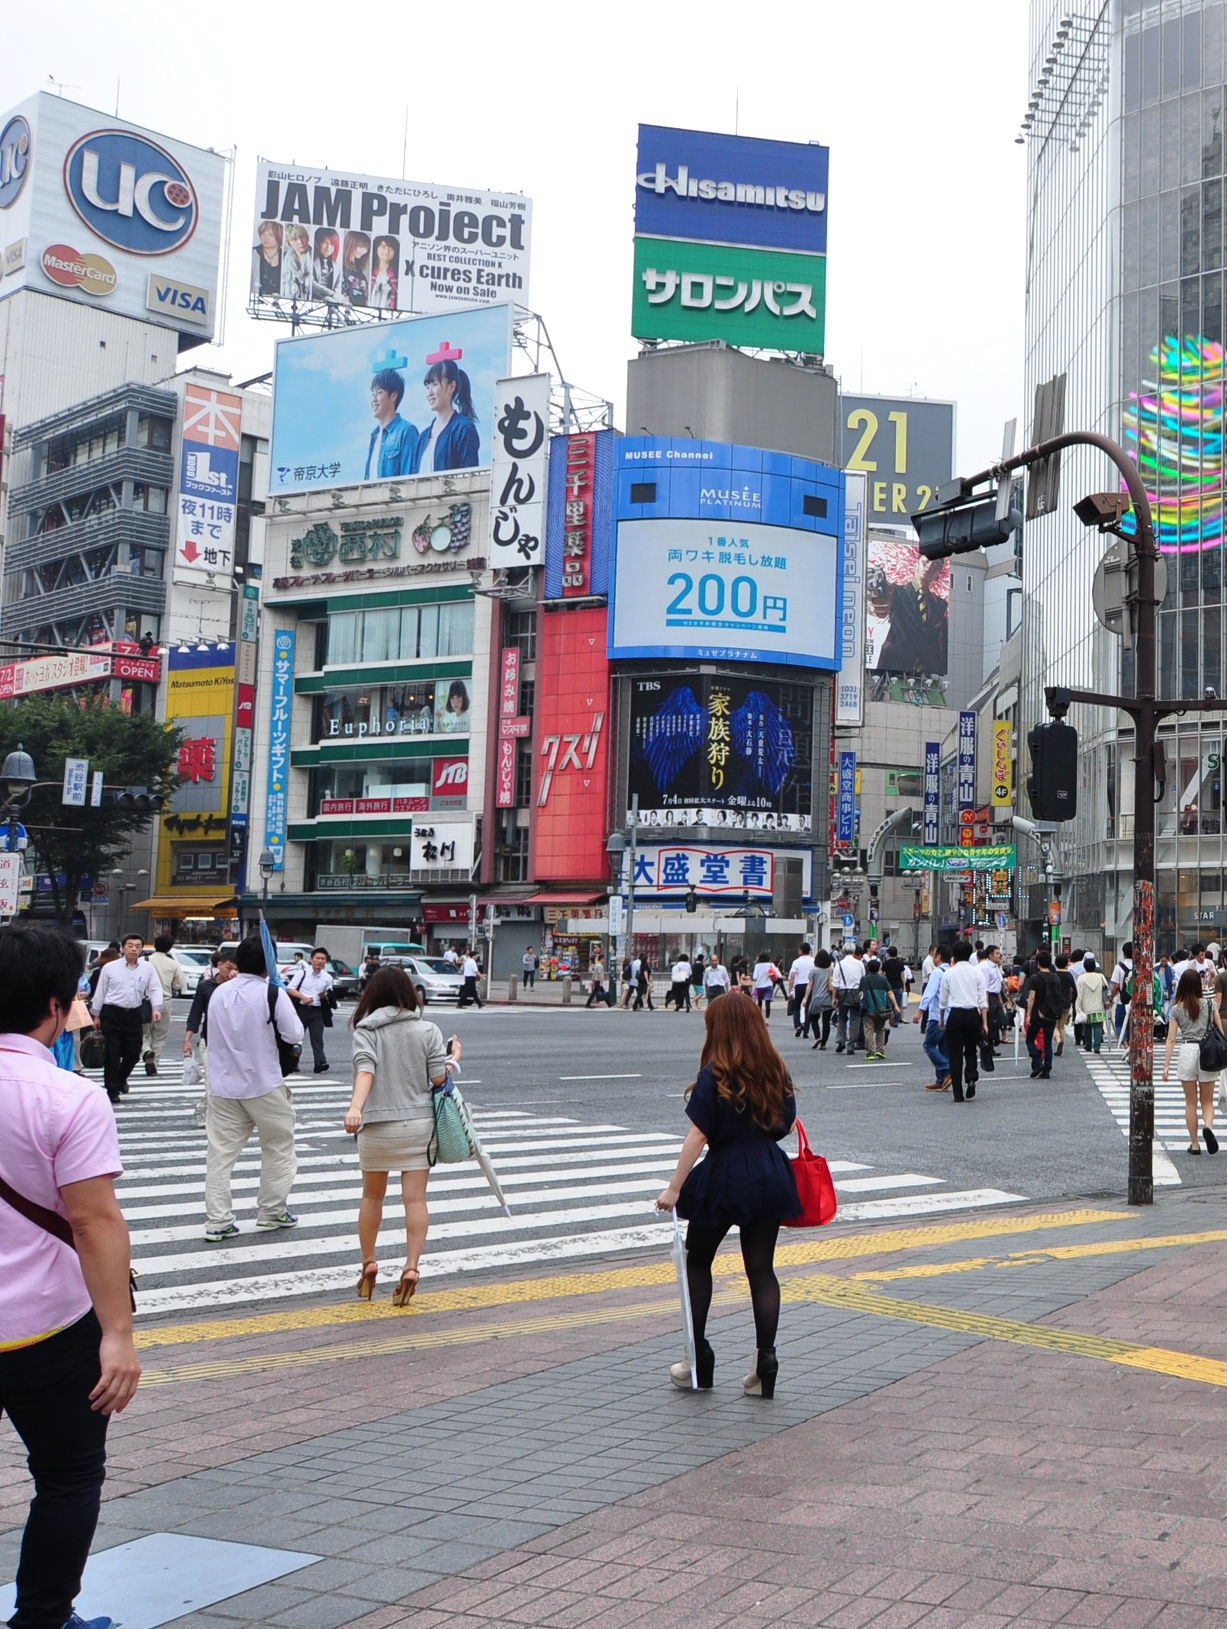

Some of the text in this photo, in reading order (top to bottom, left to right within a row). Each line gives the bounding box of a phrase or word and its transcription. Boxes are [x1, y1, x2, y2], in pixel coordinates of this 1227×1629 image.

[637, 163, 825, 211] Hisamitsu
[261, 180, 525, 250] JAM Project
[43, 254, 115, 285] MasterCard
[427, 252, 449, 264] BEST
[451, 255, 494, 268] COLLECTION
[405, 260, 522, 289] X cures Earth
[156, 283, 207, 315] VISA
[430, 281, 497, 299] Now on Sale
[642, 268, 817, 318] サロンパス
[184, 391, 241, 446] 本
[846, 408, 908, 473] 21
[625, 450, 713, 460] MUSEE Channel
[294, 462, 341, 482] 帝京大学
[493, 396, 544, 560] もんじゃ
[185, 481, 232, 496] ブックファースト
[873, 481, 907, 513] ER
[182, 499, 232, 523] 夜11時
[562, 438, 589, 588] 三千里薬品
[700, 498, 761, 509] PLATINUM
[191, 520, 222, 539] まで
[204, 547, 231, 566] 地下
[668, 549, 787, 570] 両ワキ脱毛し放題
[666, 572, 787, 621] 200円
[697, 649, 758, 659] ミュゼプラチナム
[121, 665, 154, 678] OPEN
[171, 677, 213, 689] Matsumoto
[503, 652, 516, 713] お好み焼
[637, 681, 661, 691] TBS
[841, 685, 857, 693] (03)
[839, 700, 858, 708] 2468
[271, 660, 290, 783] サマーフルーツギフト
[329, 715, 427, 738] Euphoria
[707, 693, 731, 790] 家族狩り
[177, 736, 217, 783] 薬
[500, 741, 512, 804] もんじゃ焼
[960, 717, 974, 802] 洋服の青山
[435, 762, 468, 788] JTB
[841, 757, 855, 835] 大盛堂商事ビル
[926, 754, 939, 844] 洋服の青山
[996, 787, 1007, 797] 4F
[323, 801, 388, 812] 国内旅行 海外旅行
